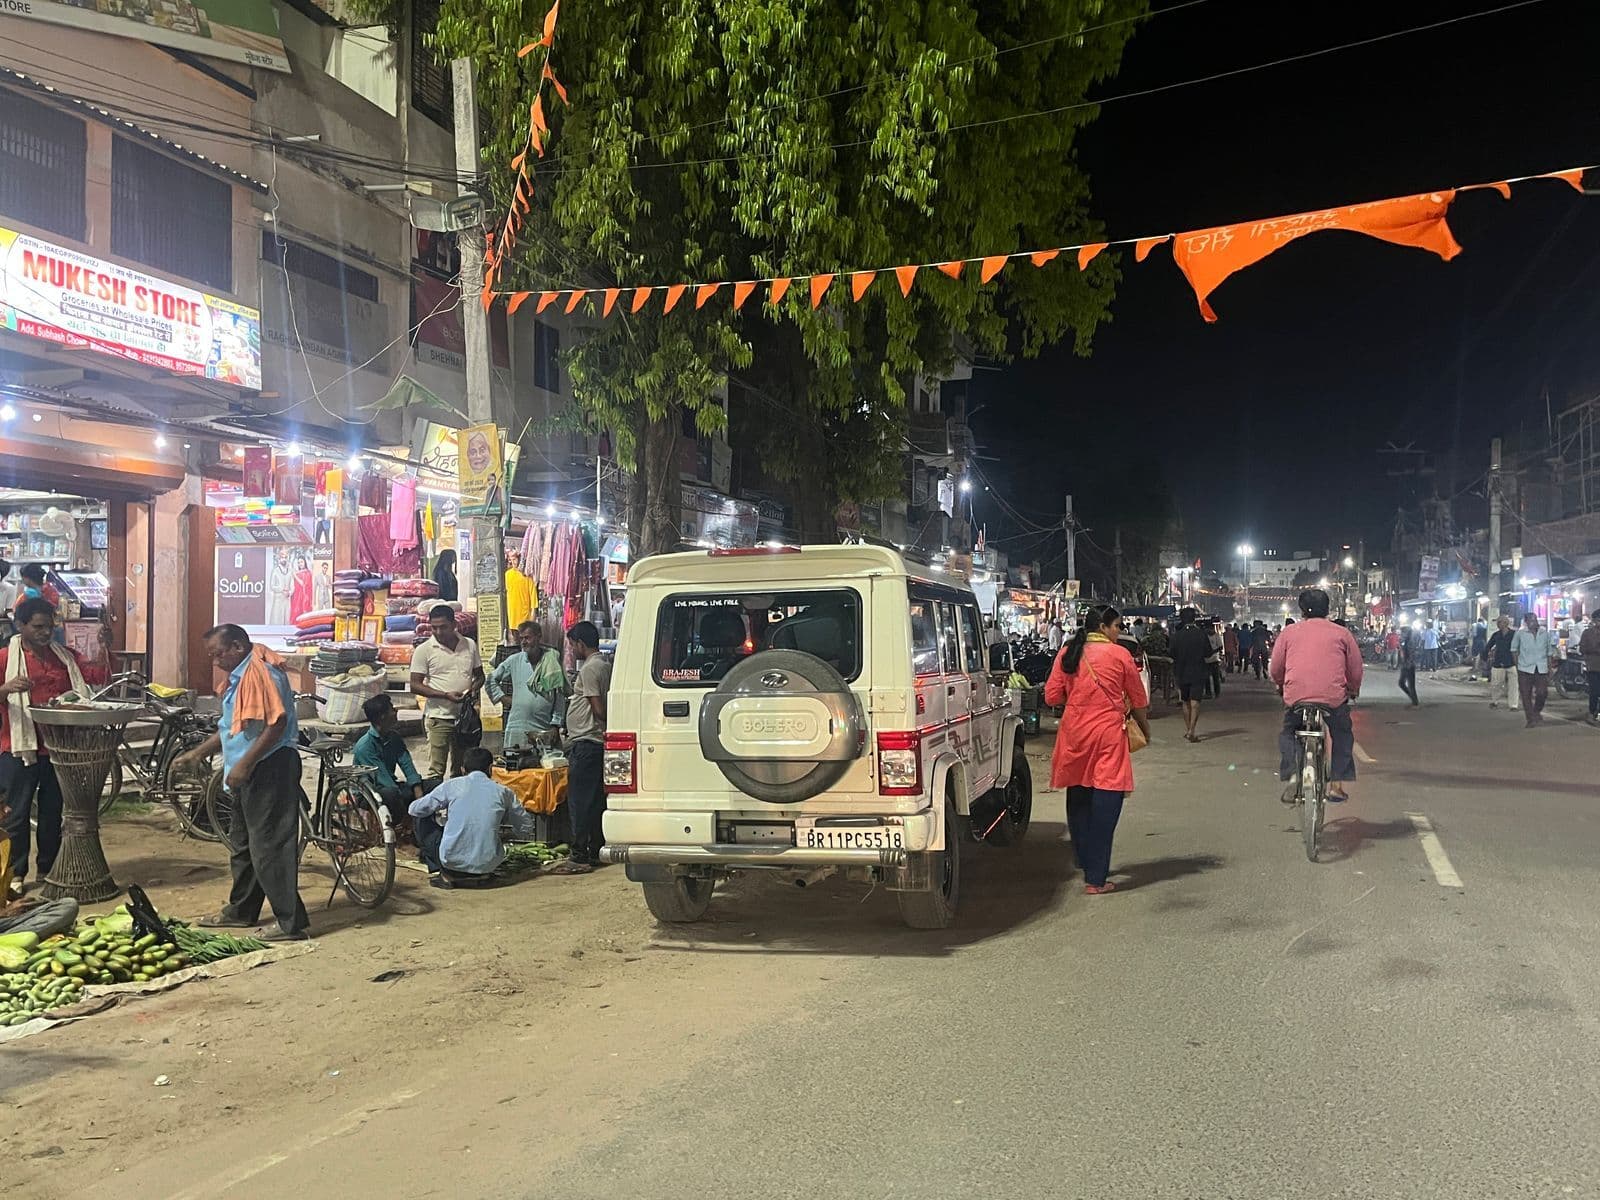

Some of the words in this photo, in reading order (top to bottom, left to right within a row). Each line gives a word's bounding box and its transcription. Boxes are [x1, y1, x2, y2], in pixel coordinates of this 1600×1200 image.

[23, 249, 127, 306] MUKESH
[134, 284, 201, 328] STORE
[61, 291, 100, 312] Groceries
[102, 304, 109, 313] at
[112, 306, 149, 325] Wholesale
[151, 317, 173, 331] Prices
[37, 326, 65, 342] Subhash
[219, 574, 264, 594] Solino
[663, 668, 700, 676] BRAJESH
[742, 718, 807, 735] BOLERO
[807, 832, 902, 849] BR11PC5518
